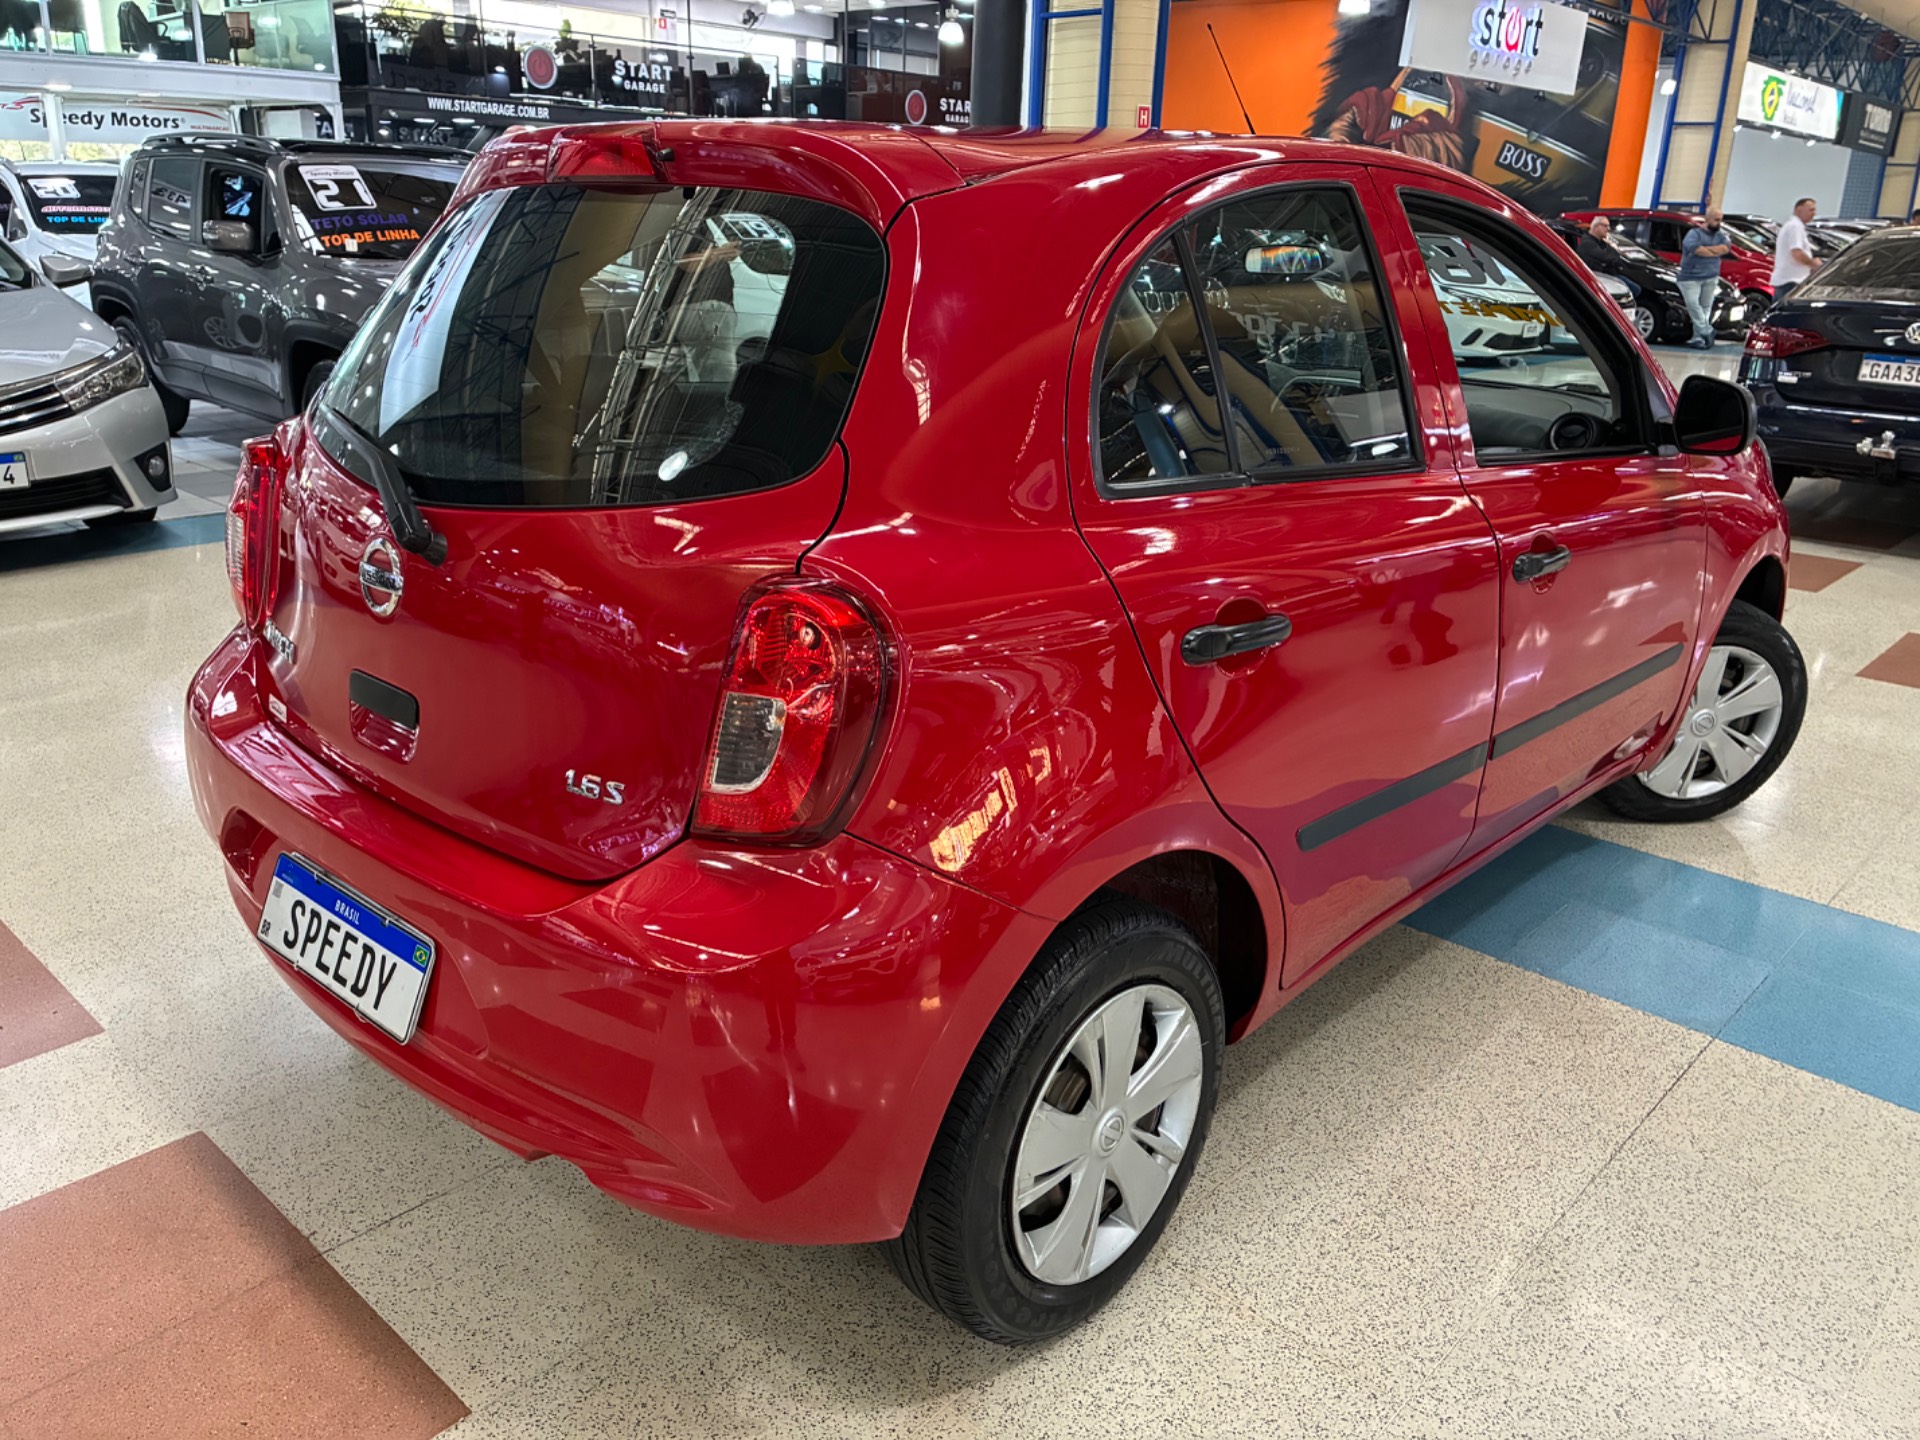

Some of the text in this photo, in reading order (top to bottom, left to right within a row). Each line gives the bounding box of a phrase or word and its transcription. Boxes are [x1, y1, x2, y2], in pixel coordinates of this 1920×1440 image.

[614, 60, 673, 81] START
[624, 80, 666, 94] GARAGE
[427, 97, 550, 120] WWW.STARTGARAGE.COM.BR
[940, 98, 971, 113] STAR
[30, 108, 180, 130] Sedy Motors
[945, 114, 969, 124] GARAG
[1139, 109, 1148, 126] H
[1499, 143, 1547, 177] BOSS
[312, 179, 373, 208] 21
[311, 213, 409, 230] TETO SOLAR
[321, 229, 420, 247] TOP DE LINHA
[4, 464, 15, 485] 4
[335, 899, 360, 926] BRASIL
[283, 900, 397, 1011] SPEEDY
